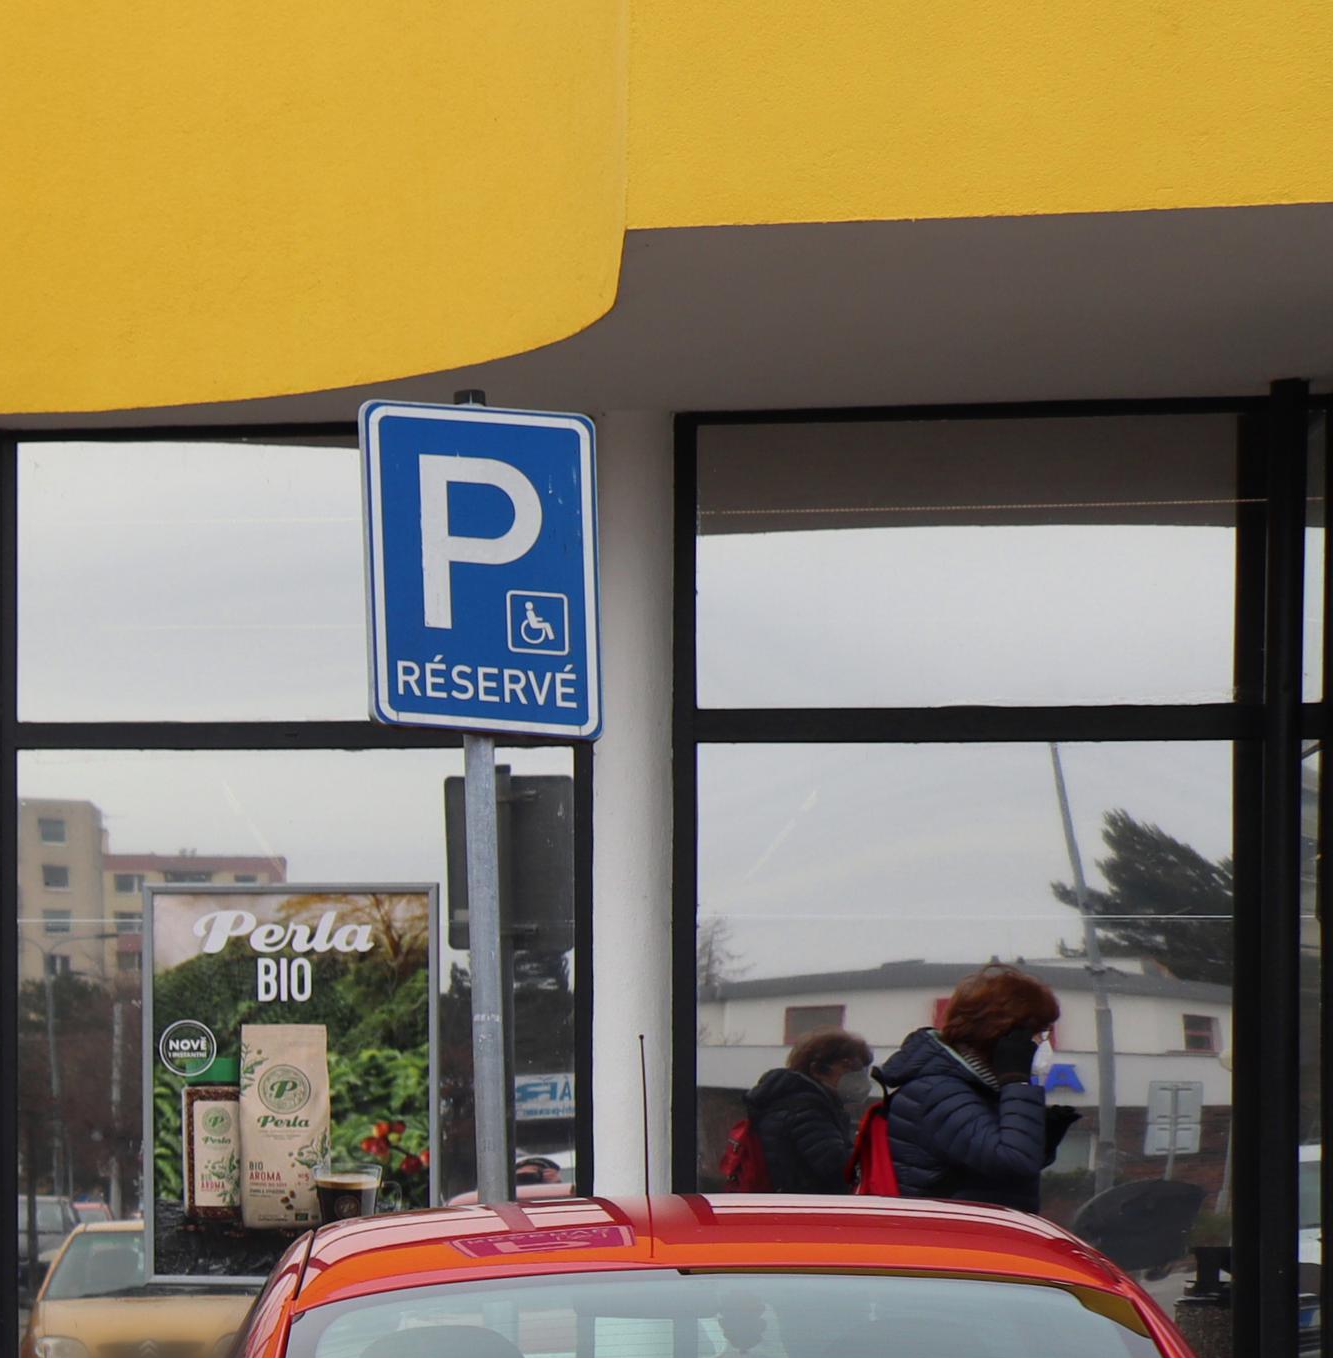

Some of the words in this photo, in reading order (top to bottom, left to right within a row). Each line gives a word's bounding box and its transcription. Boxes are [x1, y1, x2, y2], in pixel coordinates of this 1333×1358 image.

[419, 453, 543, 630] P
[396, 654, 578, 709] RÉSERVÉ
[192, 909, 375, 954] Perla
[257, 957, 313, 1003] BIO
[168, 1036, 208, 1051] NOVĚ
[256, 1115, 310, 1128] Perla
[249, 1161, 264, 1171] BIO
[249, 1171, 282, 1181] AROMA
